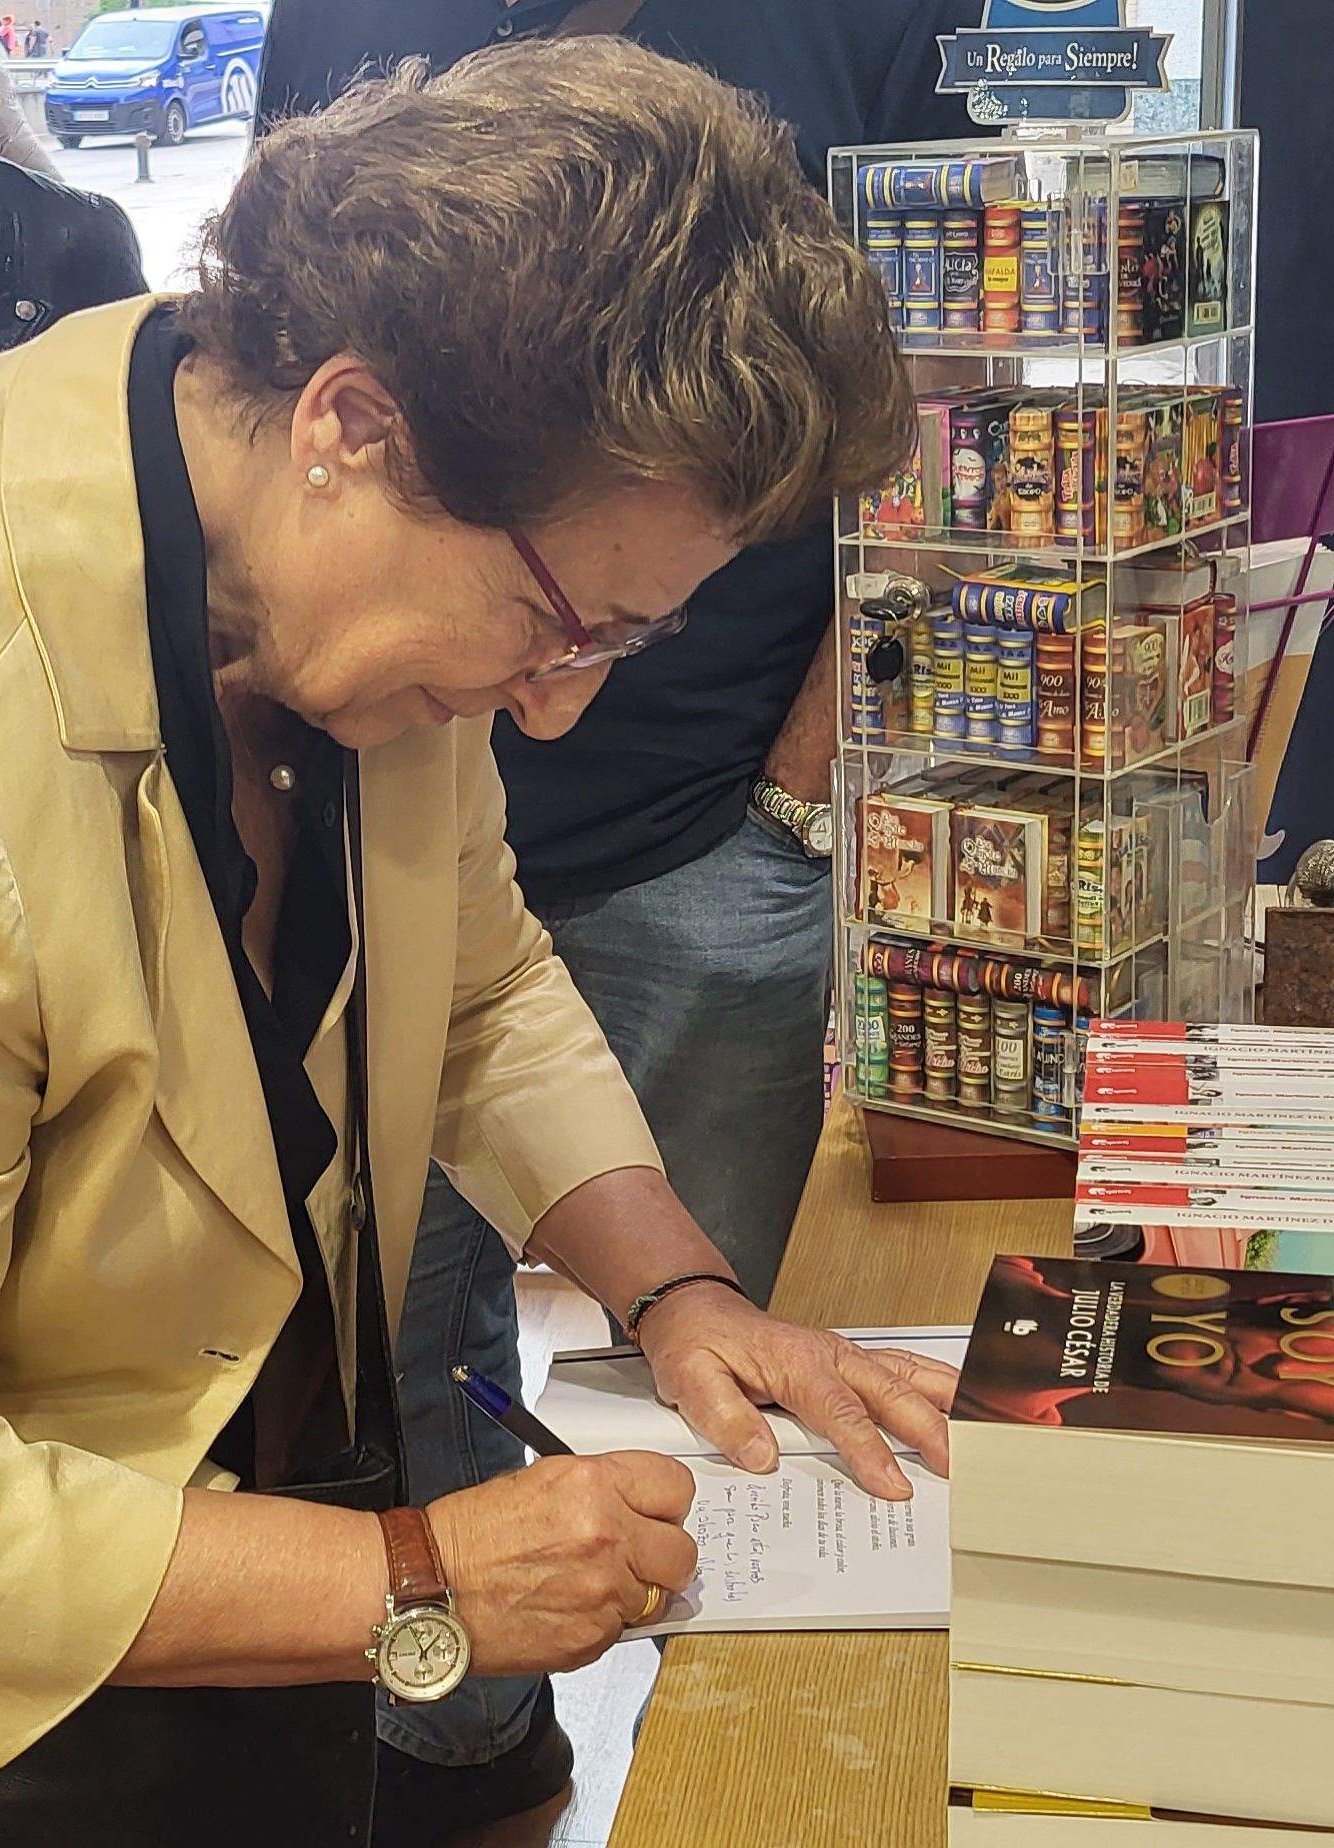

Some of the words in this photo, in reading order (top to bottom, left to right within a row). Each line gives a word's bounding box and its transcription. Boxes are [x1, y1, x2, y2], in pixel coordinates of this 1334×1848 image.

[967, 51, 983, 66] Un
[1038, 54, 1062, 70] para
[1065, 41, 1138, 72] Siempre!
[1176, 1212, 1239, 1220] IGNACIO
[1242, 1215, 1319, 1223] MARTÍNEZ
[1110, 1281, 1125, 1291] LA
[1070, 1289, 1100, 1328] JULIO
[1101, 1291, 1123, 1337] VERDADERA
[1060, 1330, 1096, 1378] CÉSAR
[1094, 1337, 1117, 1379] HISTORIA
[1146, 1311, 1228, 1367] YO
[1093, 1380, 1110, 1393] DE
